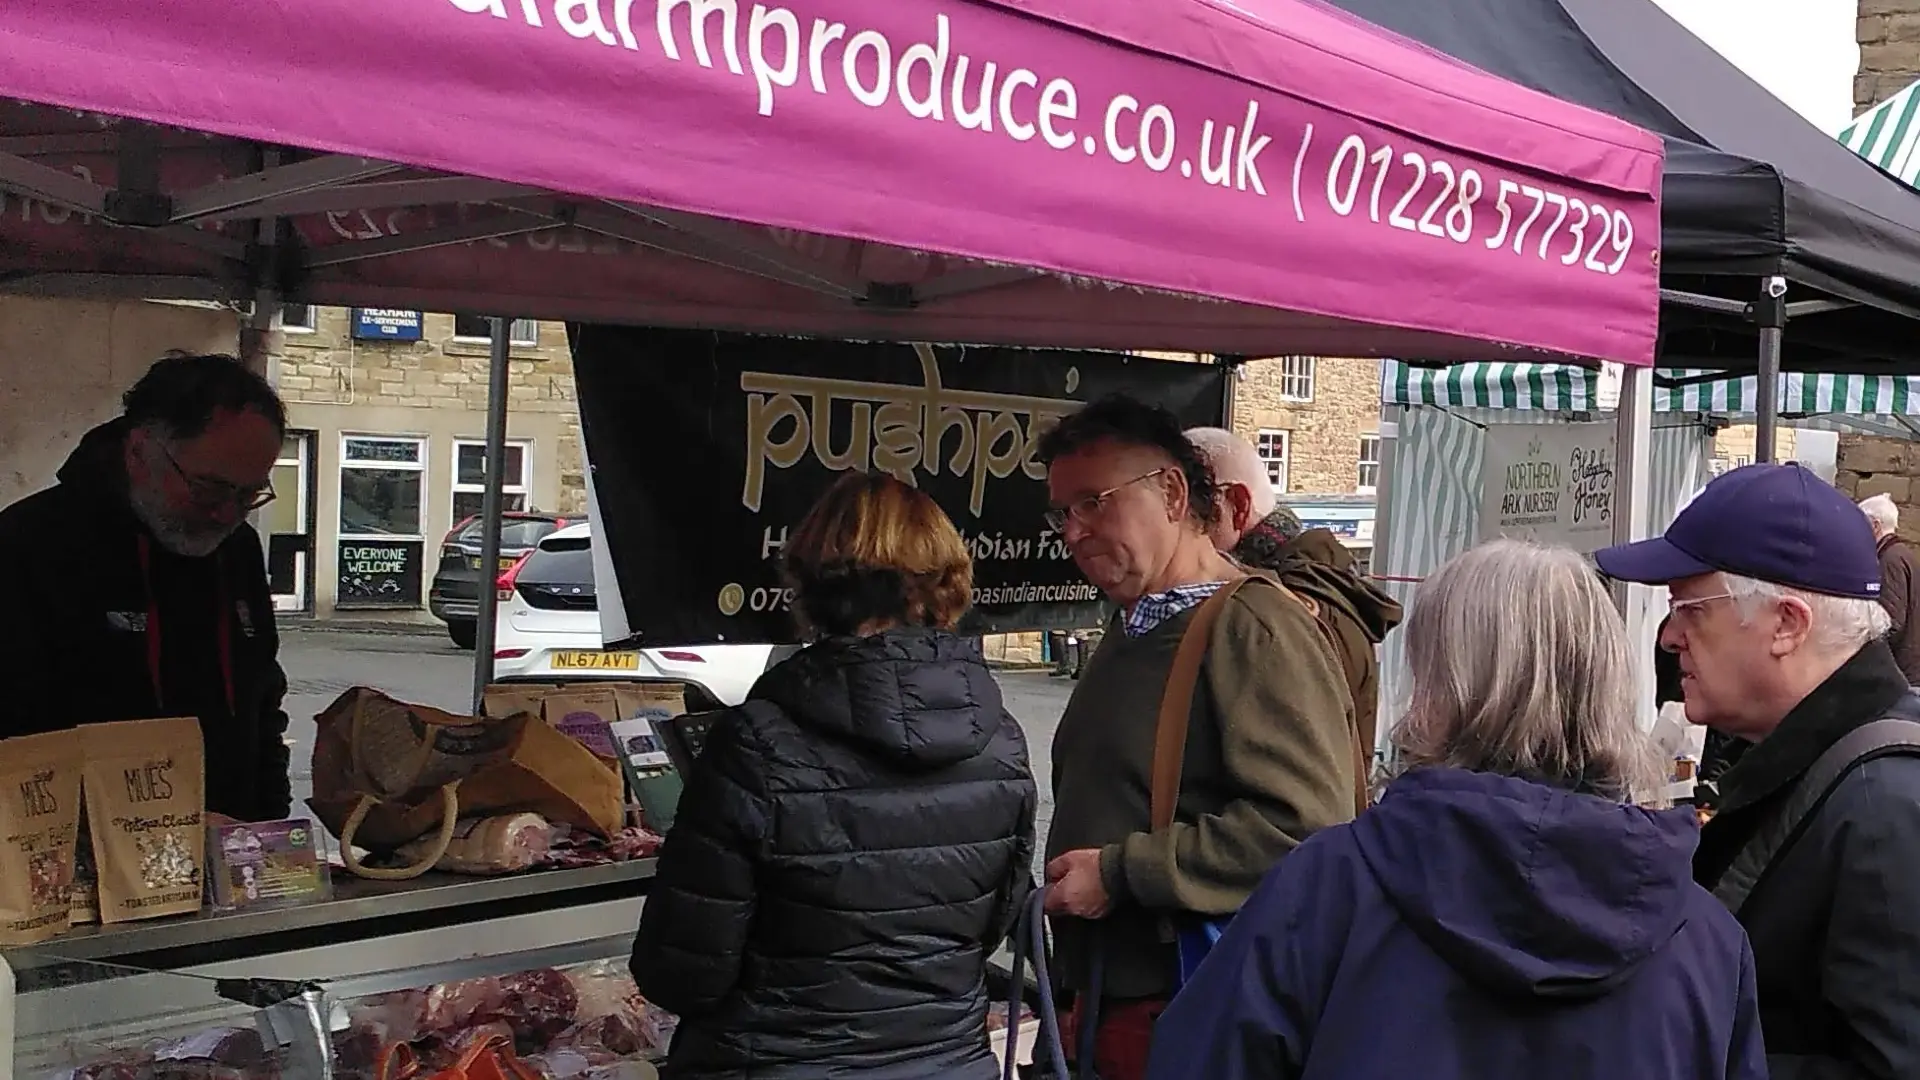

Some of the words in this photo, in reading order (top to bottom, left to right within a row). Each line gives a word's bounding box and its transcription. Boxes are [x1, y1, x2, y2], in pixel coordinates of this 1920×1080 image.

[451, 0, 1272, 197] armproduce.co.uk
[1326, 133, 1483, 243] 01228
[1485, 180, 1635, 275] 577329
[1505, 462, 1561, 490] NORTHERN
[1500, 494, 1522, 515] ARK
[1524, 491, 1560, 514] NURSERY
[1573, 481, 1612, 523] Honey
[343, 547, 407, 560] EVERYONE
[347, 561, 404, 573] WELCOME
[556, 653, 599, 667] NL67
[602, 654, 632, 668] AVT
